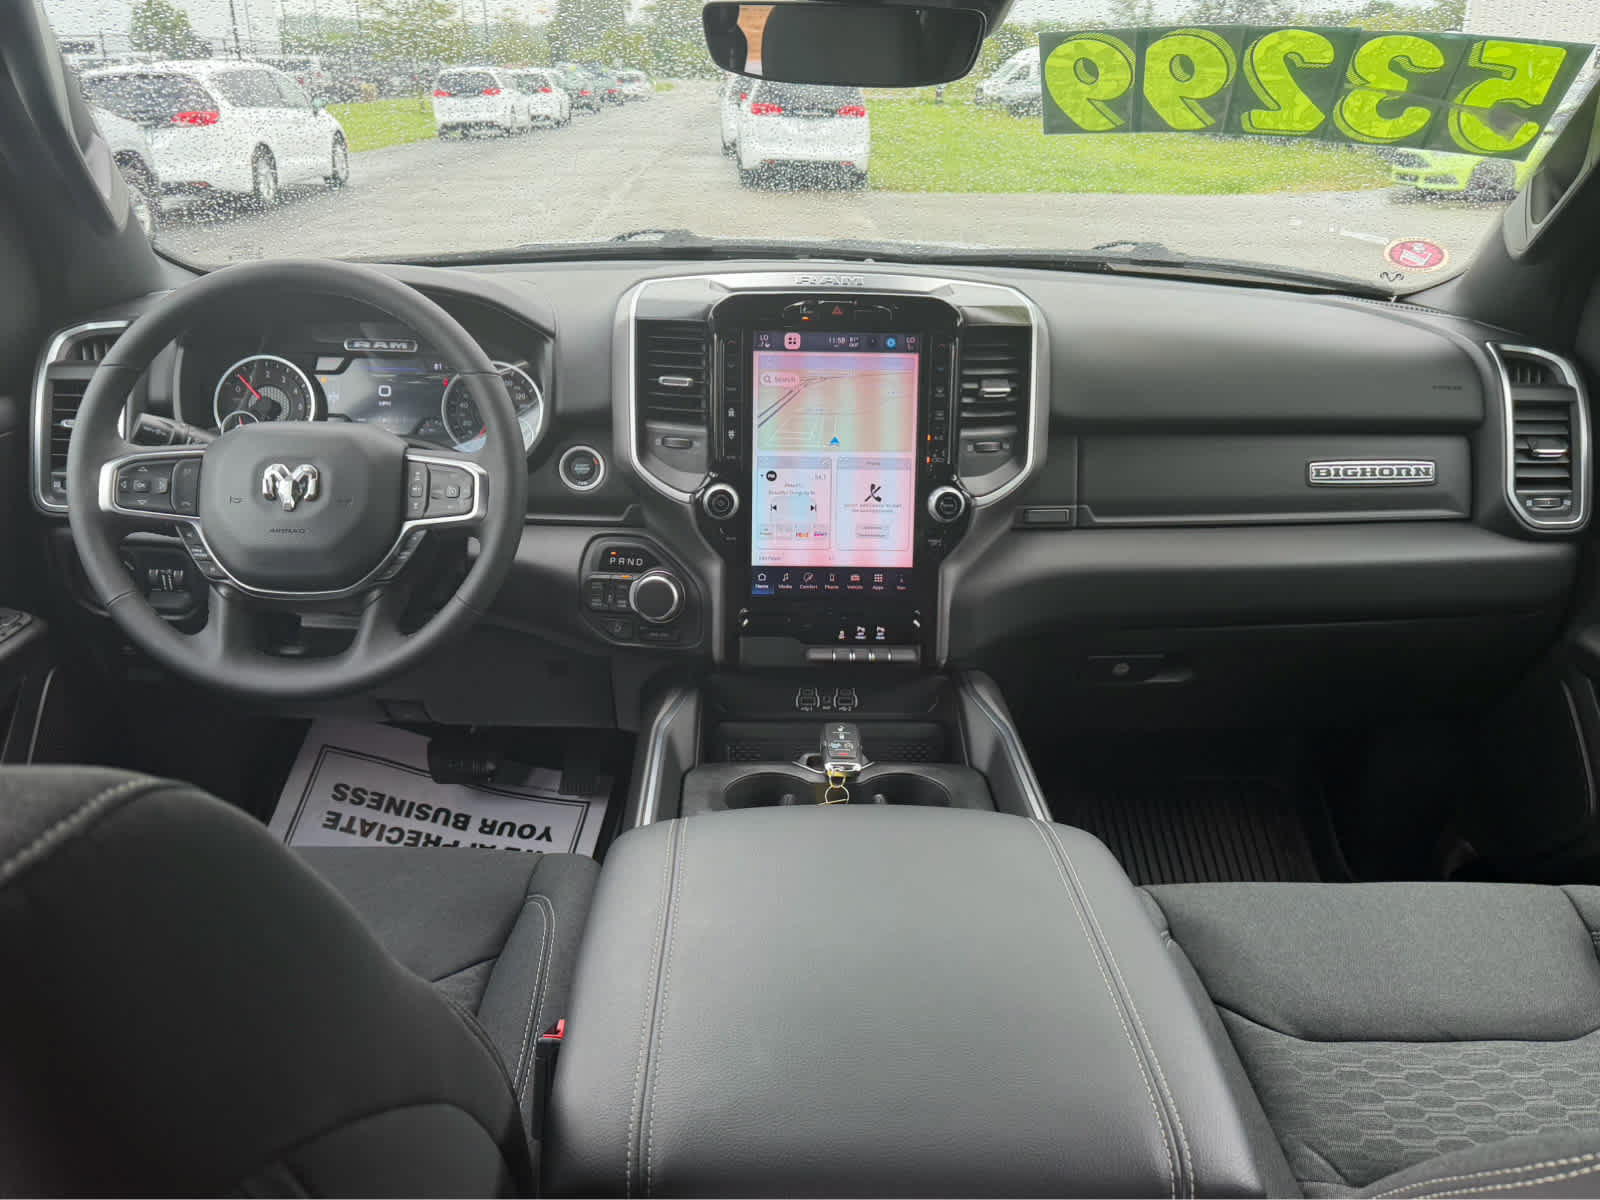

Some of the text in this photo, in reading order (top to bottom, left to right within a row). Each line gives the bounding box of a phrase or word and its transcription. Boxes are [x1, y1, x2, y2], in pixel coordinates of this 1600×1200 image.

[794, 275, 864, 287] RAM
[353, 341, 409, 350] RAM
[1313, 466, 1433, 478] BIGHORN
[330, 783, 554, 843] YOUR BUSINESS
